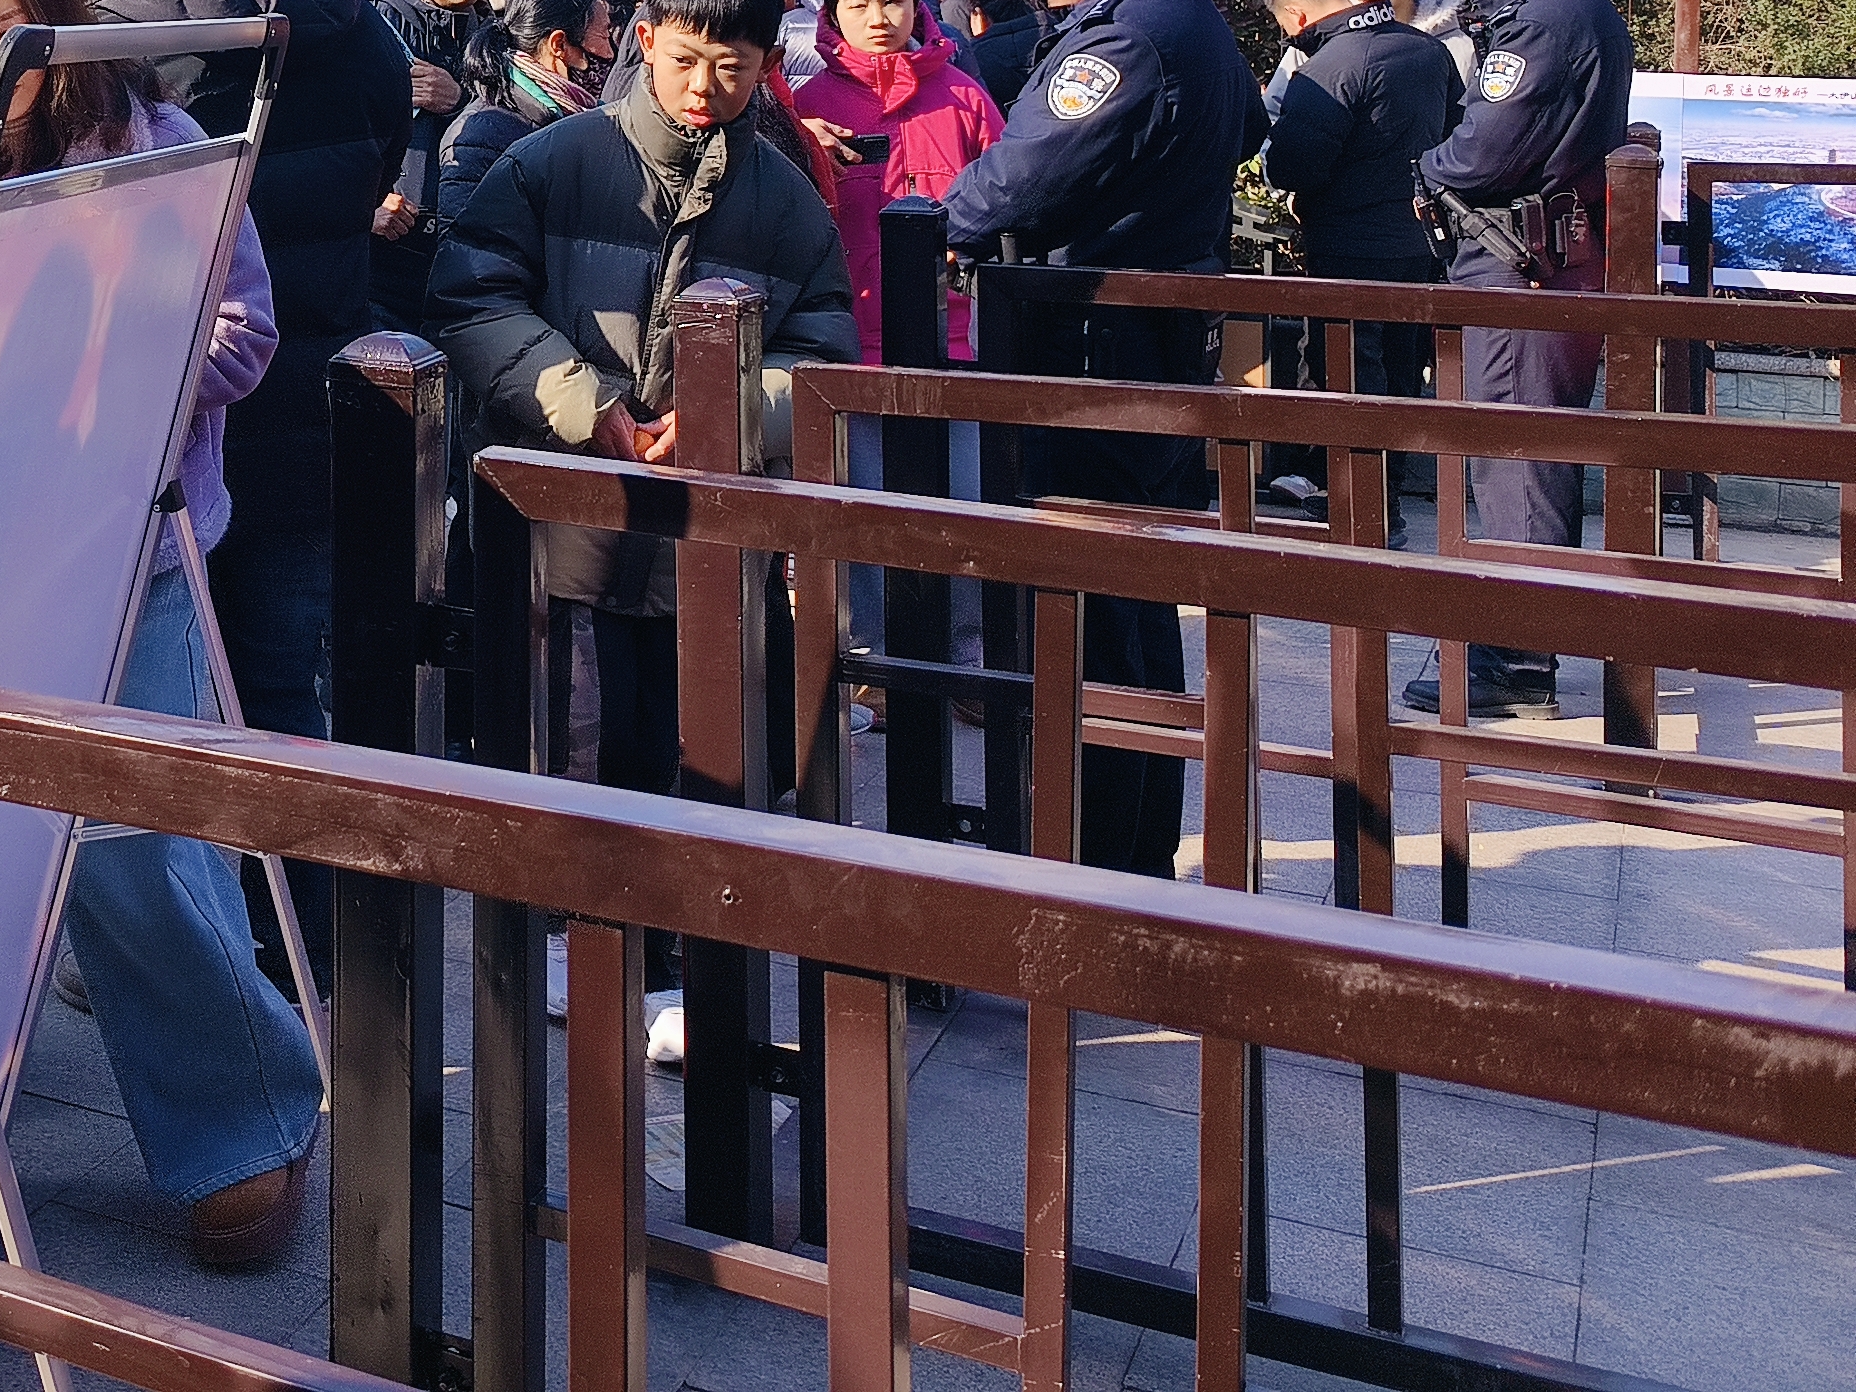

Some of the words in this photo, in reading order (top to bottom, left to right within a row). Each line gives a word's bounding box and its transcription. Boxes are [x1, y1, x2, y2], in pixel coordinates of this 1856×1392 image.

[1704, 83, 1810, 99] 风景这边独好
